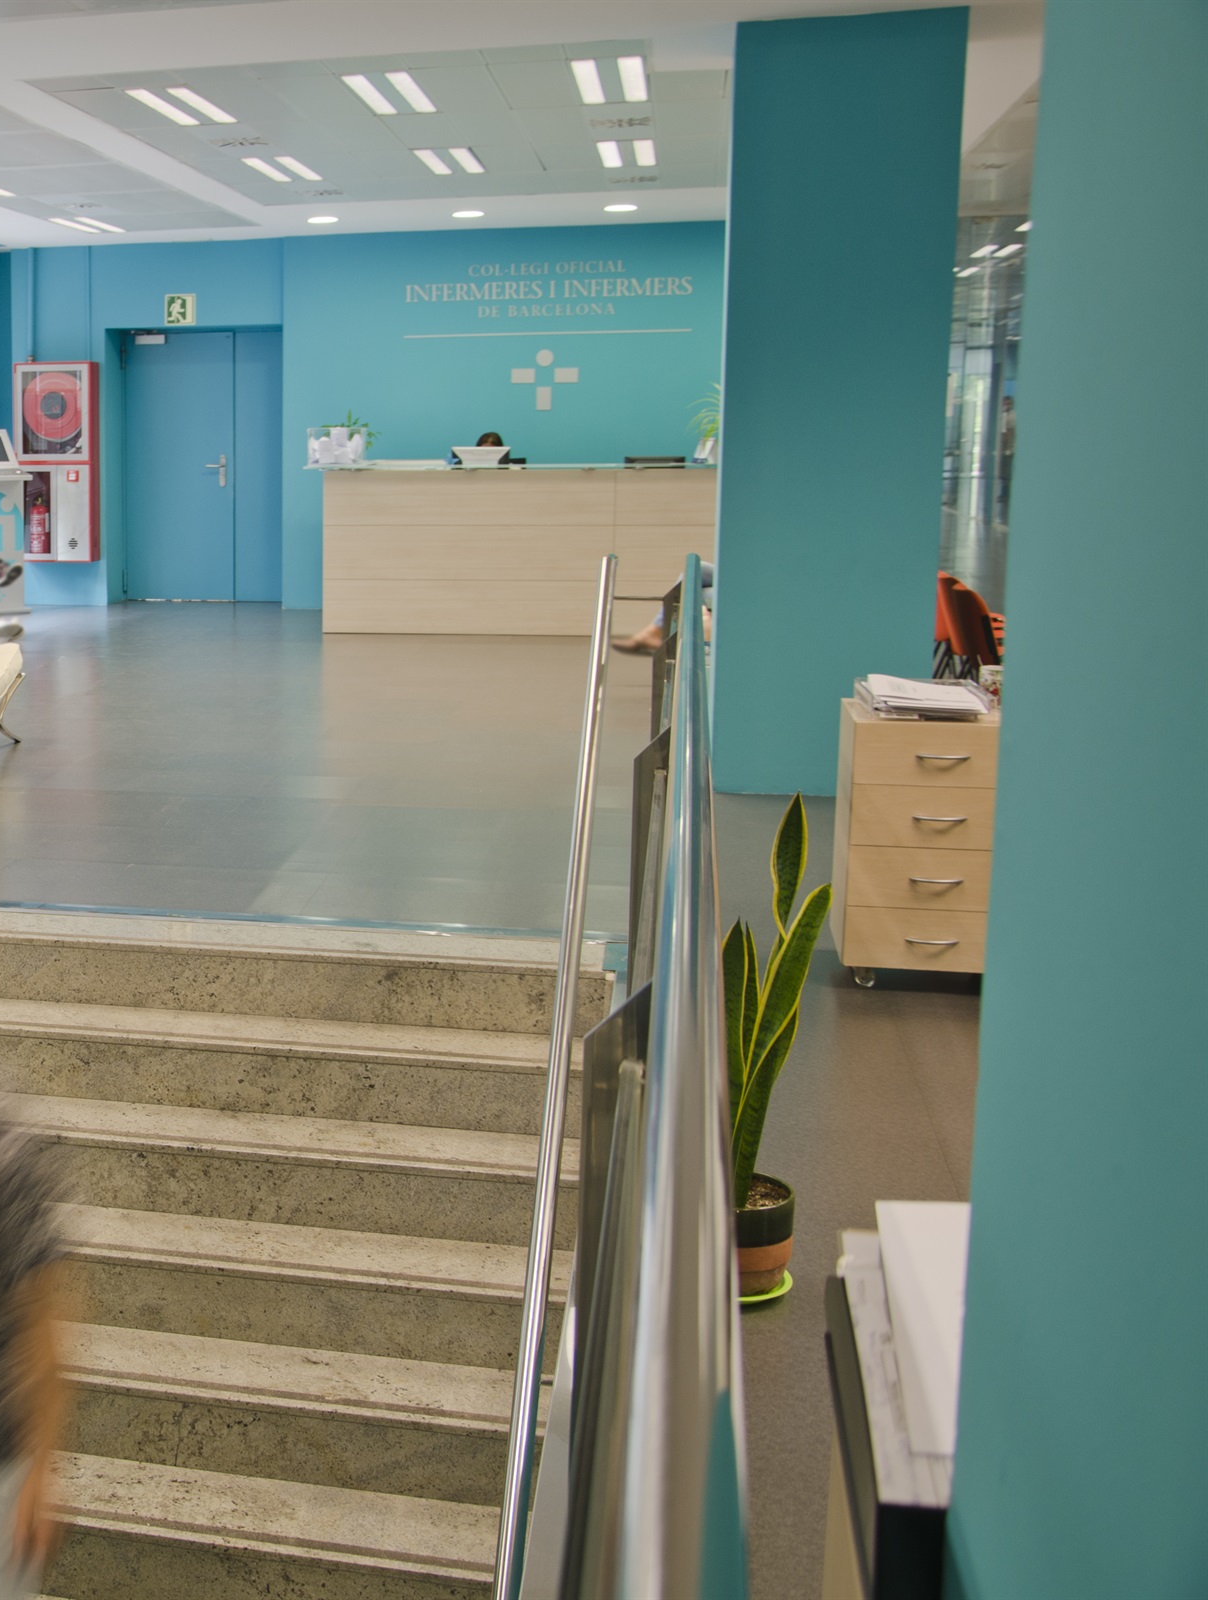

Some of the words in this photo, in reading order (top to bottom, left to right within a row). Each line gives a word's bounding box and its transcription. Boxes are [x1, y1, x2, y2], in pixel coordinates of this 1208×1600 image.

[555, 260, 627, 274] OFICIAL
[404, 280, 543, 303] INFERMERES
[549, 280, 557, 299] I
[563, 276, 693, 299] INFERMERS
[477, 305, 500, 319] DE
[507, 302, 616, 317] BARCELONA
